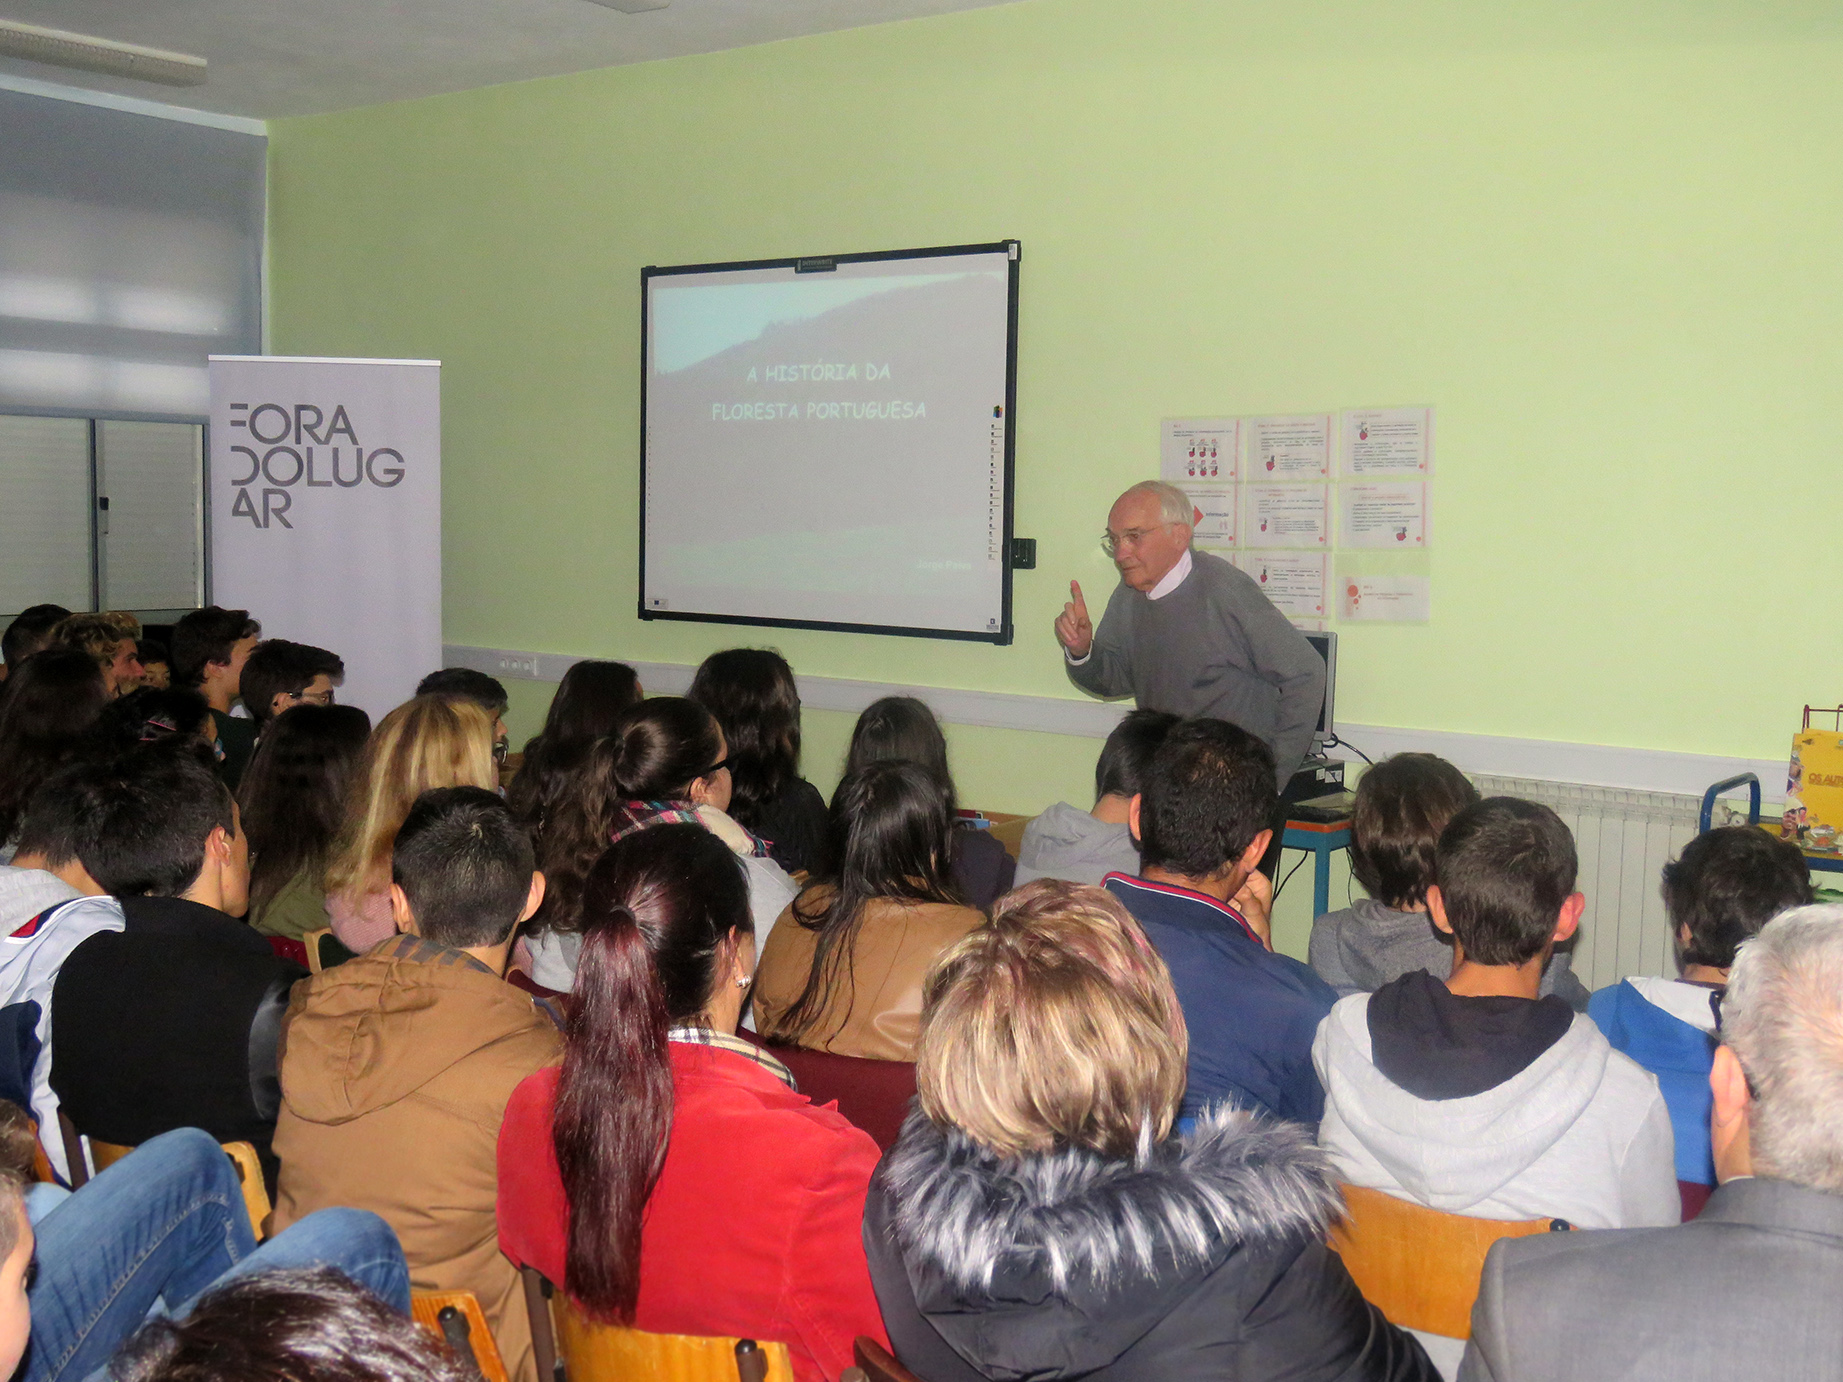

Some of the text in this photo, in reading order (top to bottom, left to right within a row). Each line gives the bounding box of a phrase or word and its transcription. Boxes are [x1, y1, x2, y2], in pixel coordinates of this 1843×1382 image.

[747, 358, 891, 382] A HISTÓRIA DA
[230, 403, 359, 445] FORA
[712, 401, 926, 421] FLORESTA PORTUGUESA
[231, 446, 405, 487] DOLUG
[231, 487, 294, 528] AR
